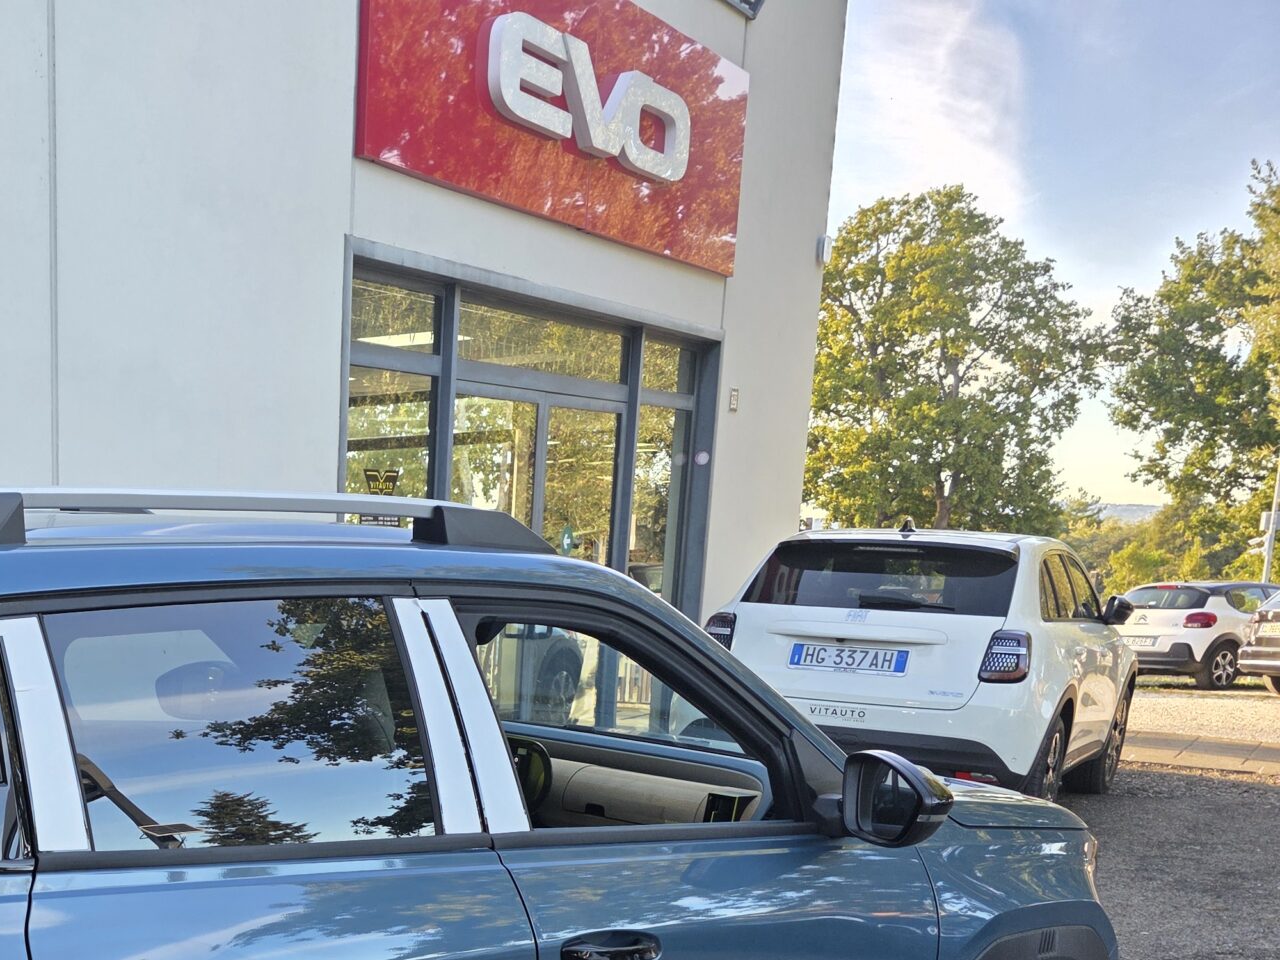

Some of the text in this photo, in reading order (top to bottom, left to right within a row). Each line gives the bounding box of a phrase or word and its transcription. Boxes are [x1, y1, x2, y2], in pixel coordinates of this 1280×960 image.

[488, 12, 690, 182] EVO
[803, 646, 827, 664] HG
[810, 706, 866, 718] VITAUTO
